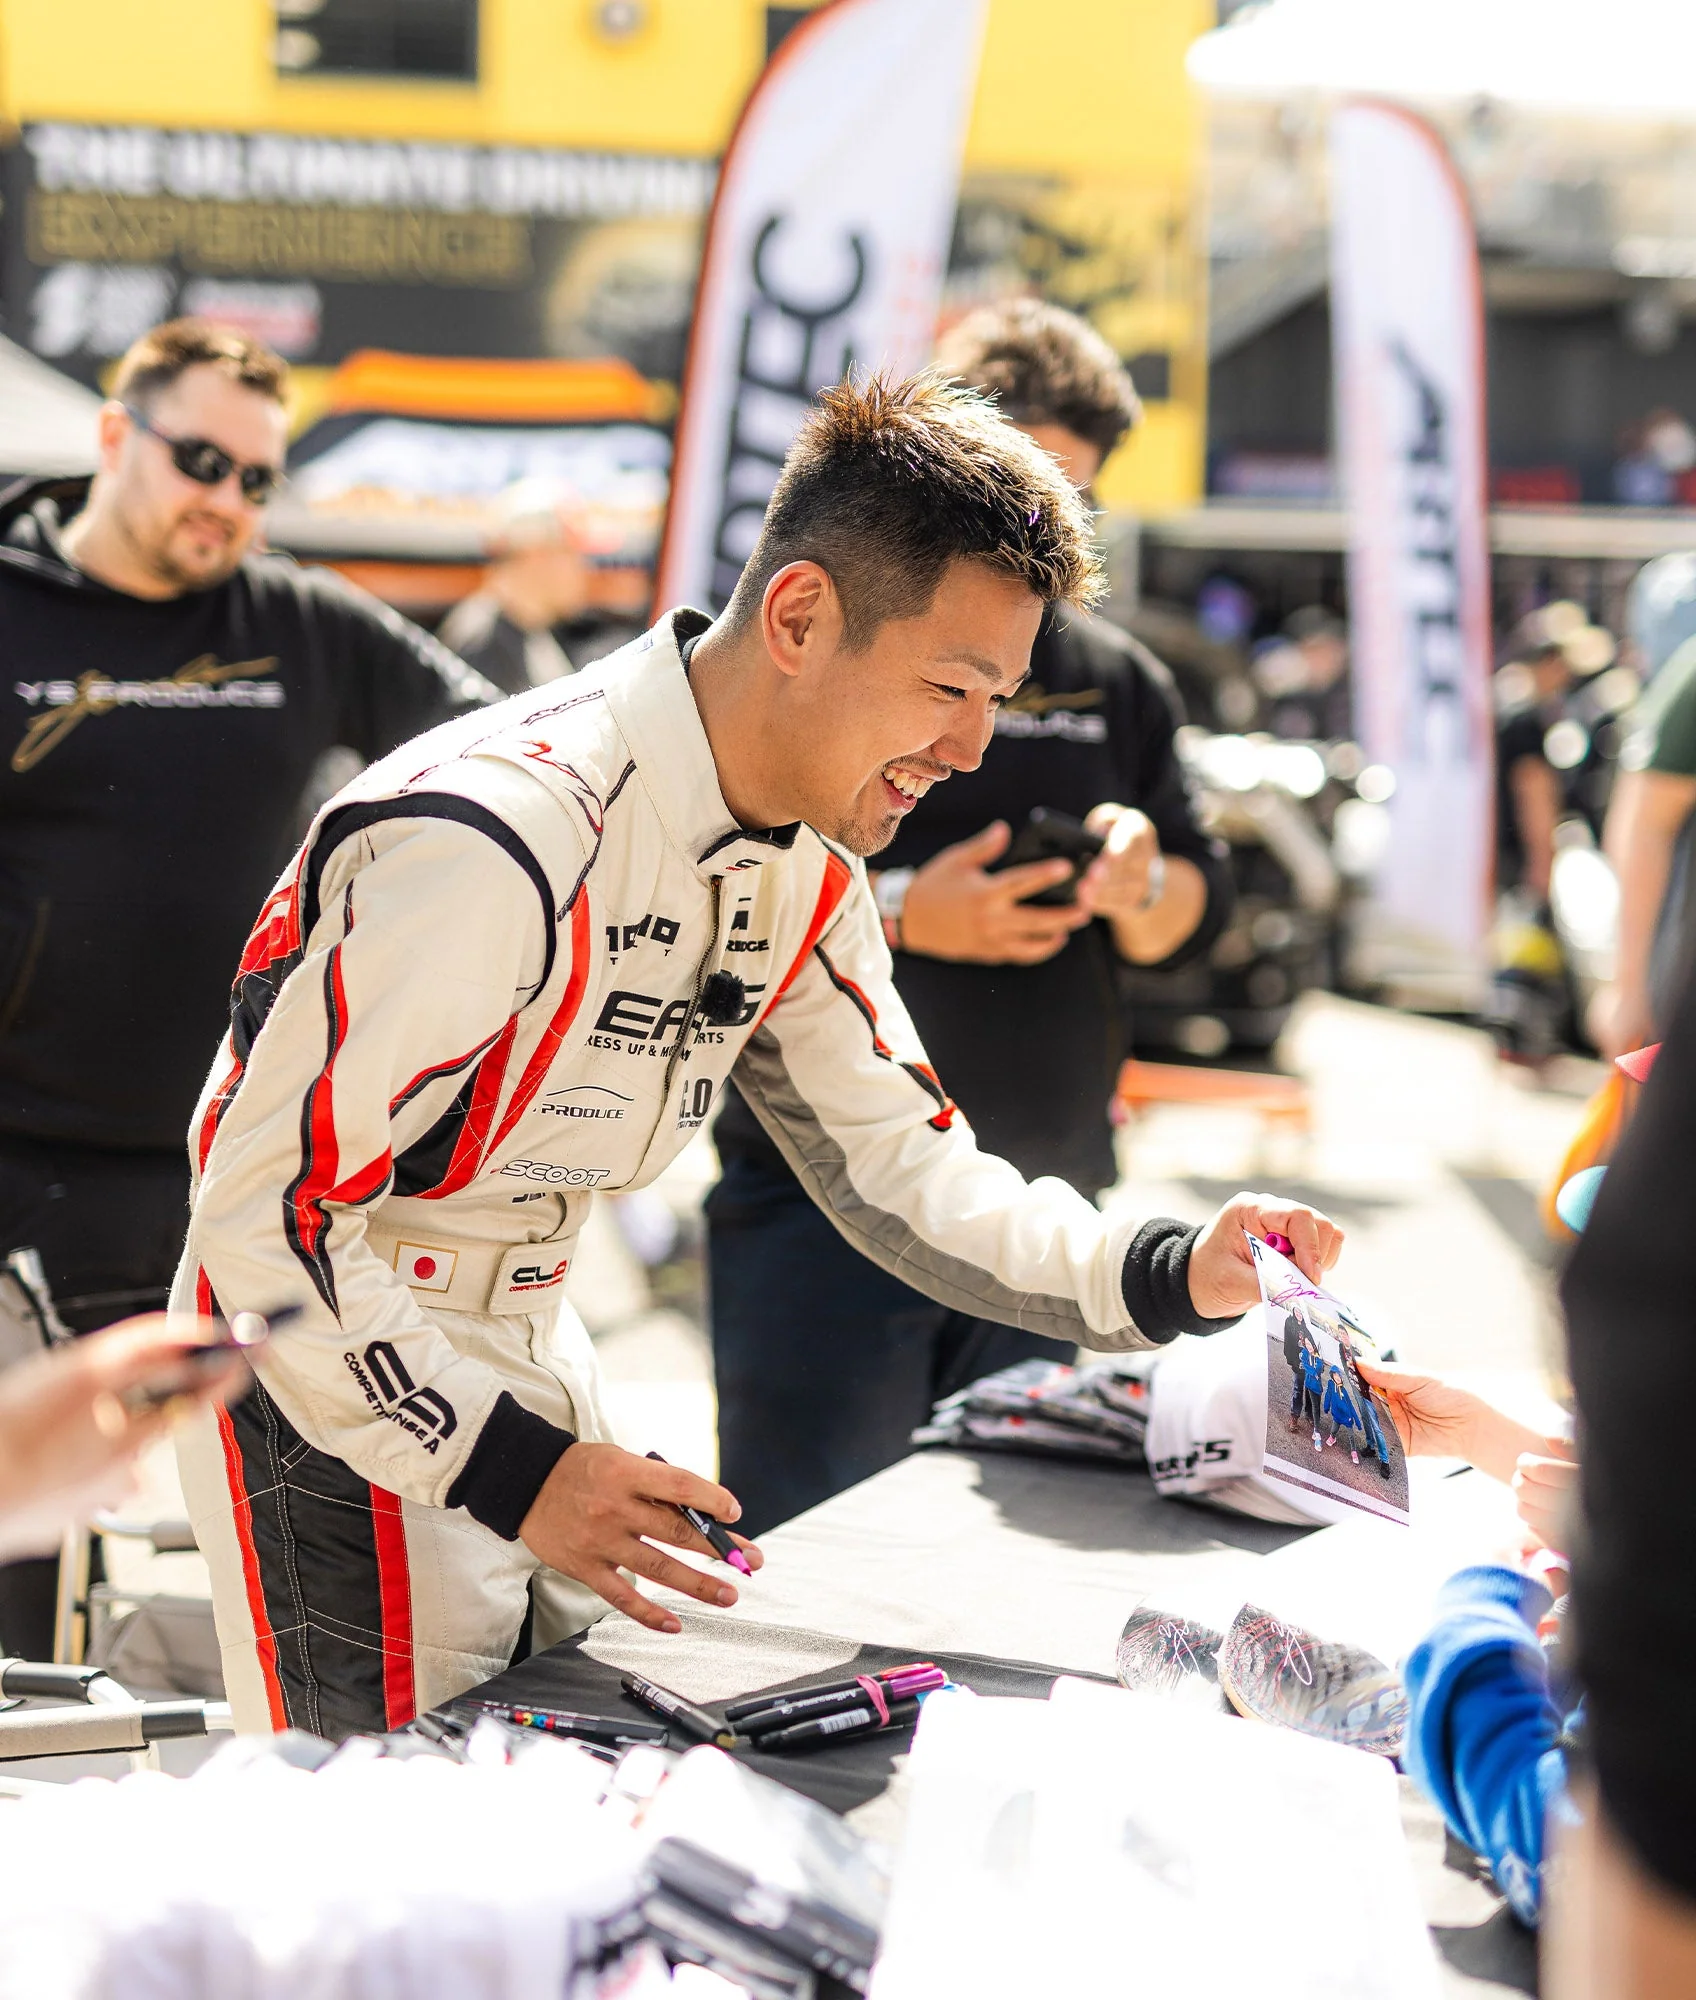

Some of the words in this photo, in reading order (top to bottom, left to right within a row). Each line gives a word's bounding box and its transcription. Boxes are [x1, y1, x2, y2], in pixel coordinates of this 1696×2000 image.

[627, 1042, 646, 1056] UP
[541, 1103, 625, 1119] PRODUCE
[500, 1159, 611, 1187] SCOOT
